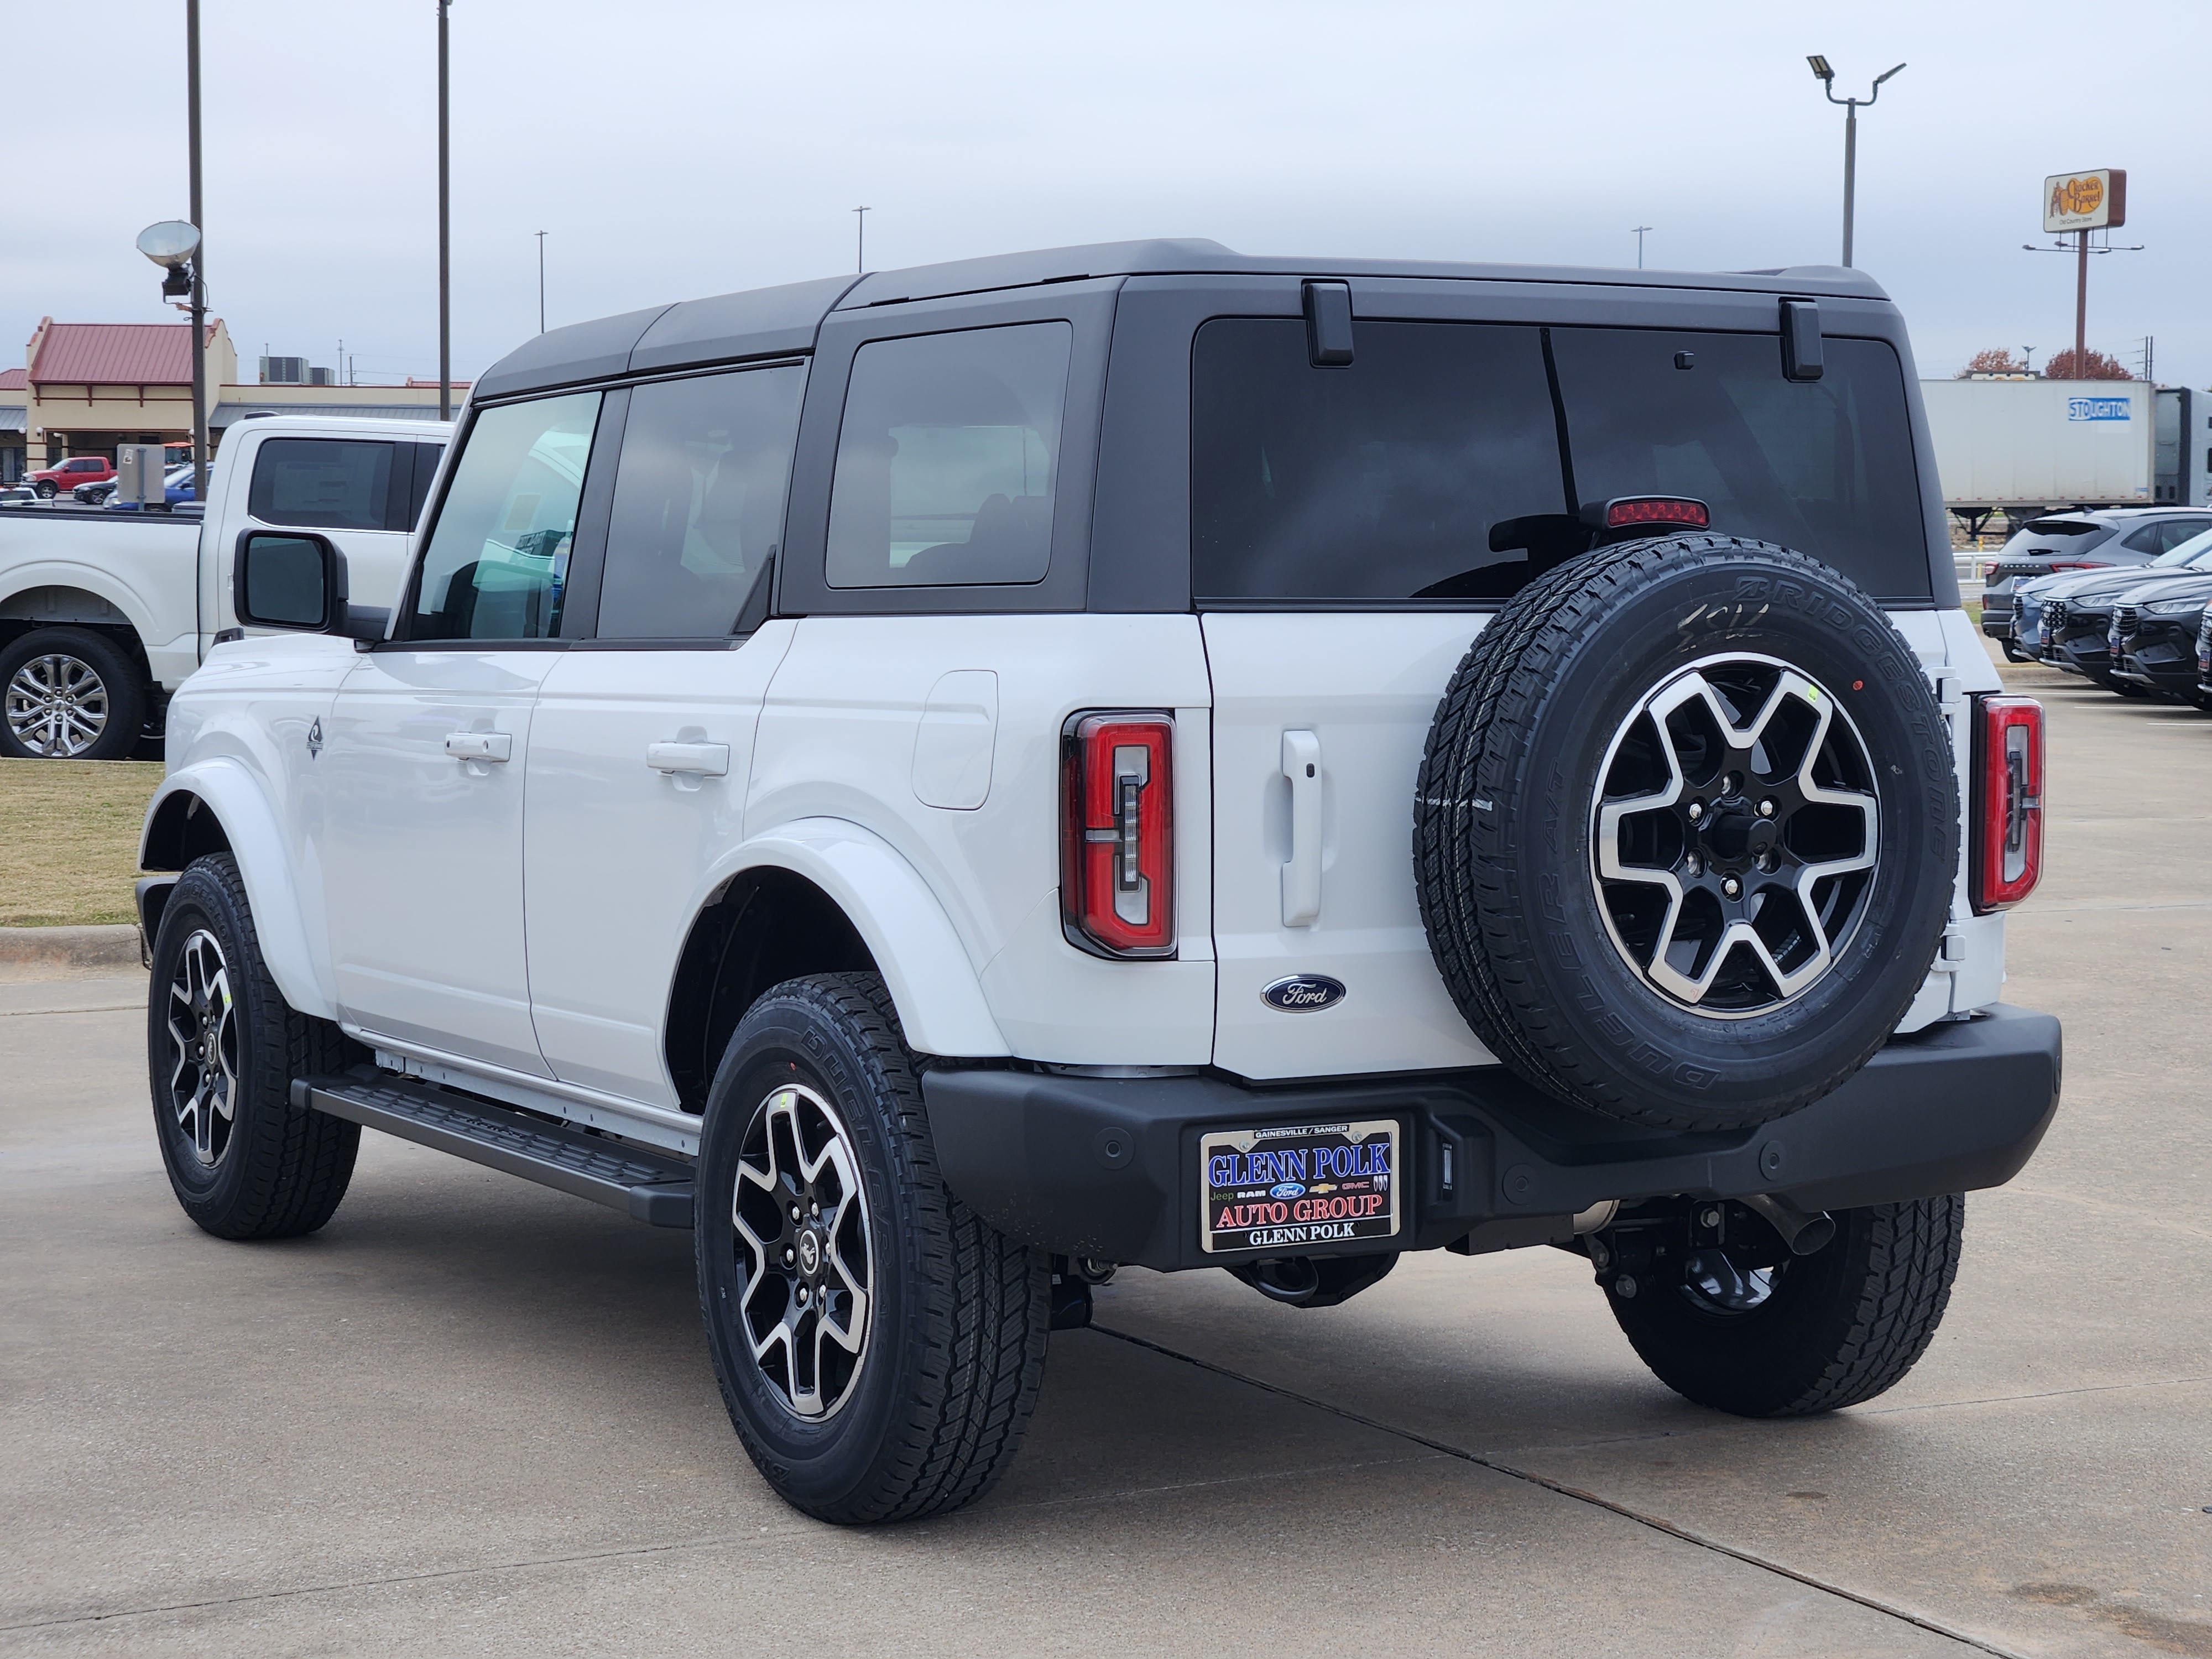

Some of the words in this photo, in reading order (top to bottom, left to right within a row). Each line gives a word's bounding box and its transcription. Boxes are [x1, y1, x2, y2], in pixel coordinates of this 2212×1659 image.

[2074, 191, 2100, 213] Barrel
[2069, 400, 2131, 418] STOUGHTON
[1731, 575, 1948, 864] BRIDGESTONE
[1538, 871, 1721, 1092] DUELER
[1282, 983, 1327, 1005] Ford
[1255, 1128, 1307, 1138] GAINESVILLE
[1314, 1125, 1348, 1134] SANGER
[1208, 1150, 1308, 1187] GLENN
[1313, 1143, 1390, 1179] POLK
[1211, 1191, 1234, 1202] Jeep
[1237, 1190, 1266, 1199] RAM
[1342, 1181, 1370, 1190] GMC
[1216, 1202, 1288, 1228] AUTO
[1293, 1194, 1383, 1222] GROUP
[1249, 1226, 1307, 1246] GLENN
[1309, 1222, 1355, 1240] POLK
